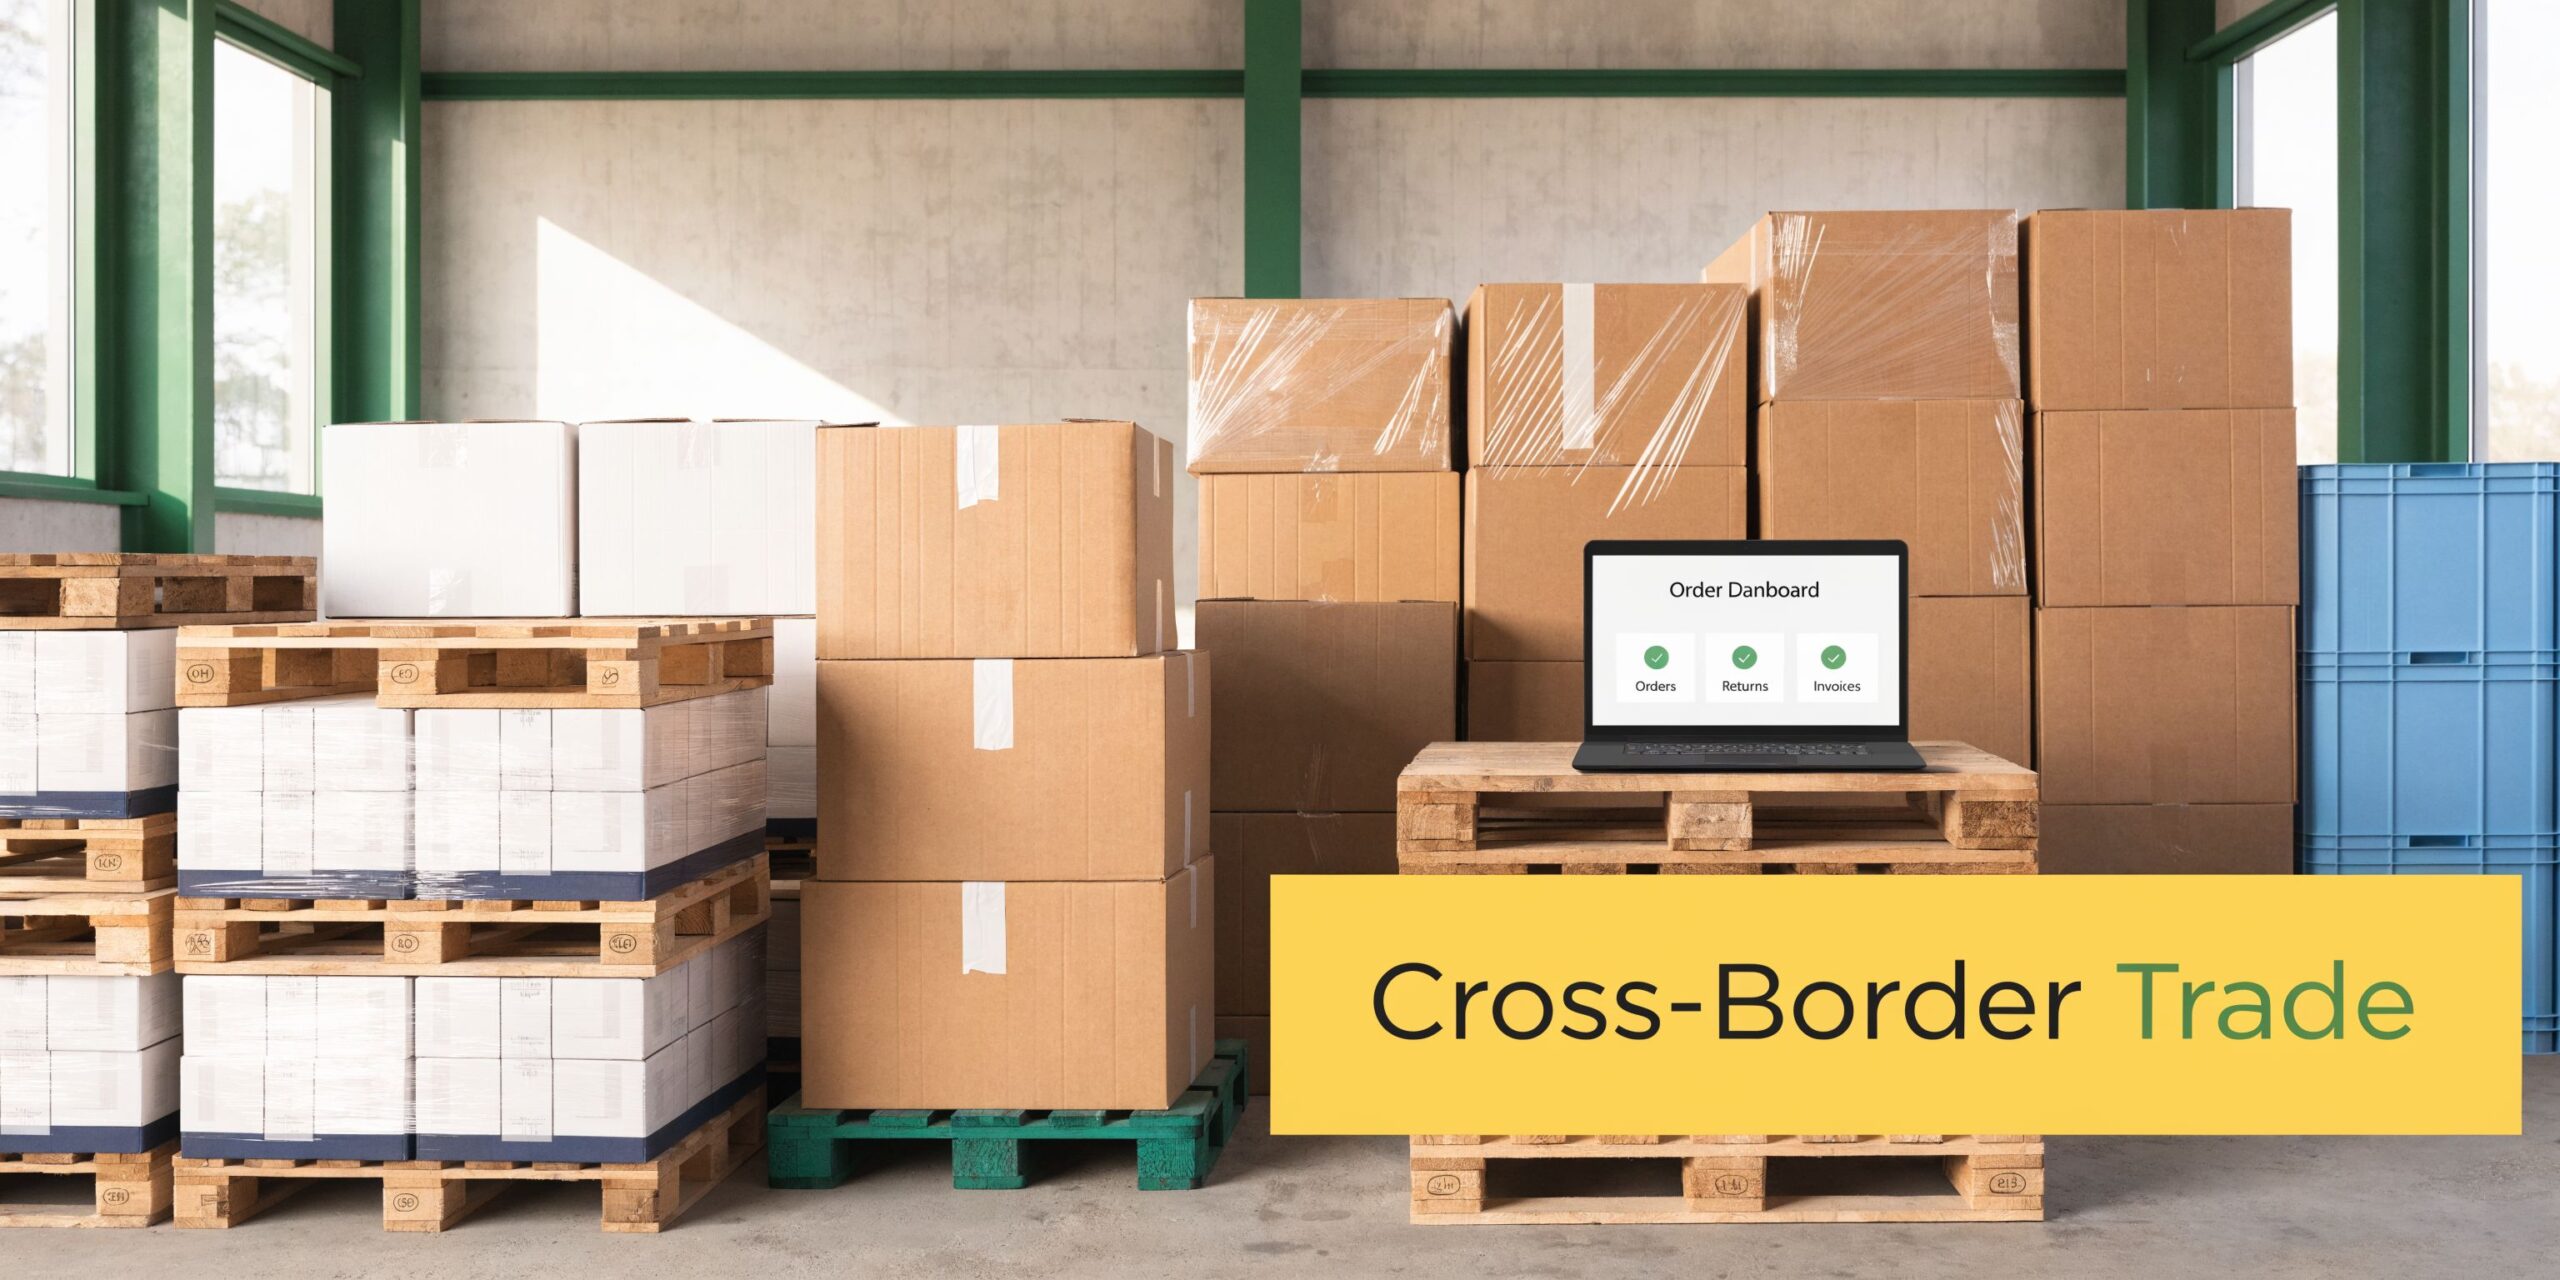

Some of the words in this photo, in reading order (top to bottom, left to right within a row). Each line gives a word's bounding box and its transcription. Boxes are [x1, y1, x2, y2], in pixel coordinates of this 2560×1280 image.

[1669, 581, 1723, 598] Order
[1728, 581, 1820, 598] Danboard
[1635, 680, 1677, 692] Orders
[1722, 680, 1769, 692] Returns
[1813, 680, 1861, 692] Invoices
